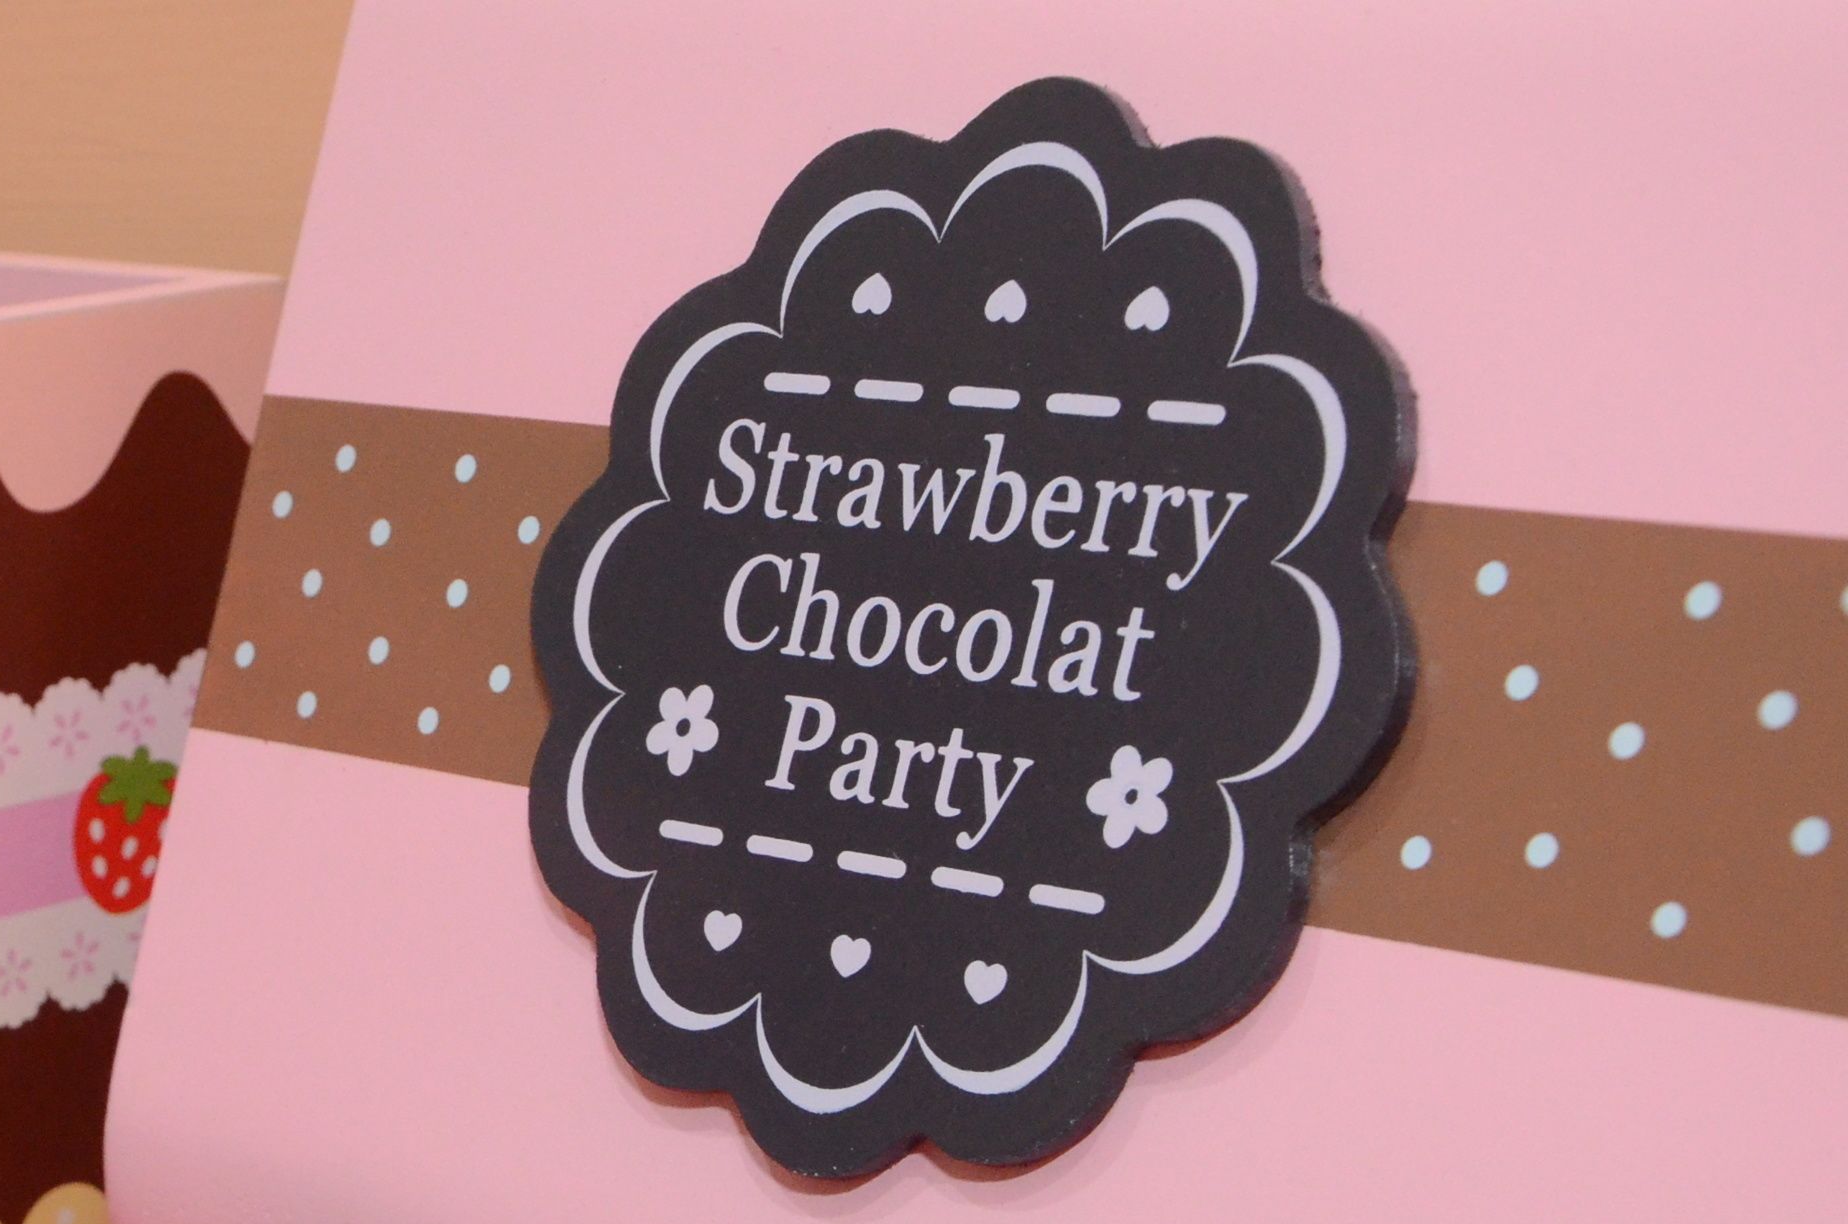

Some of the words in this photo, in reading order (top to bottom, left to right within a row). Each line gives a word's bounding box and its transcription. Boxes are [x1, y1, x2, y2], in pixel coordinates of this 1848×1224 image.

[703, 417, 1248, 591] Strawberry
[723, 552, 1155, 701] Chocolat
[764, 694, 1034, 850] Party
